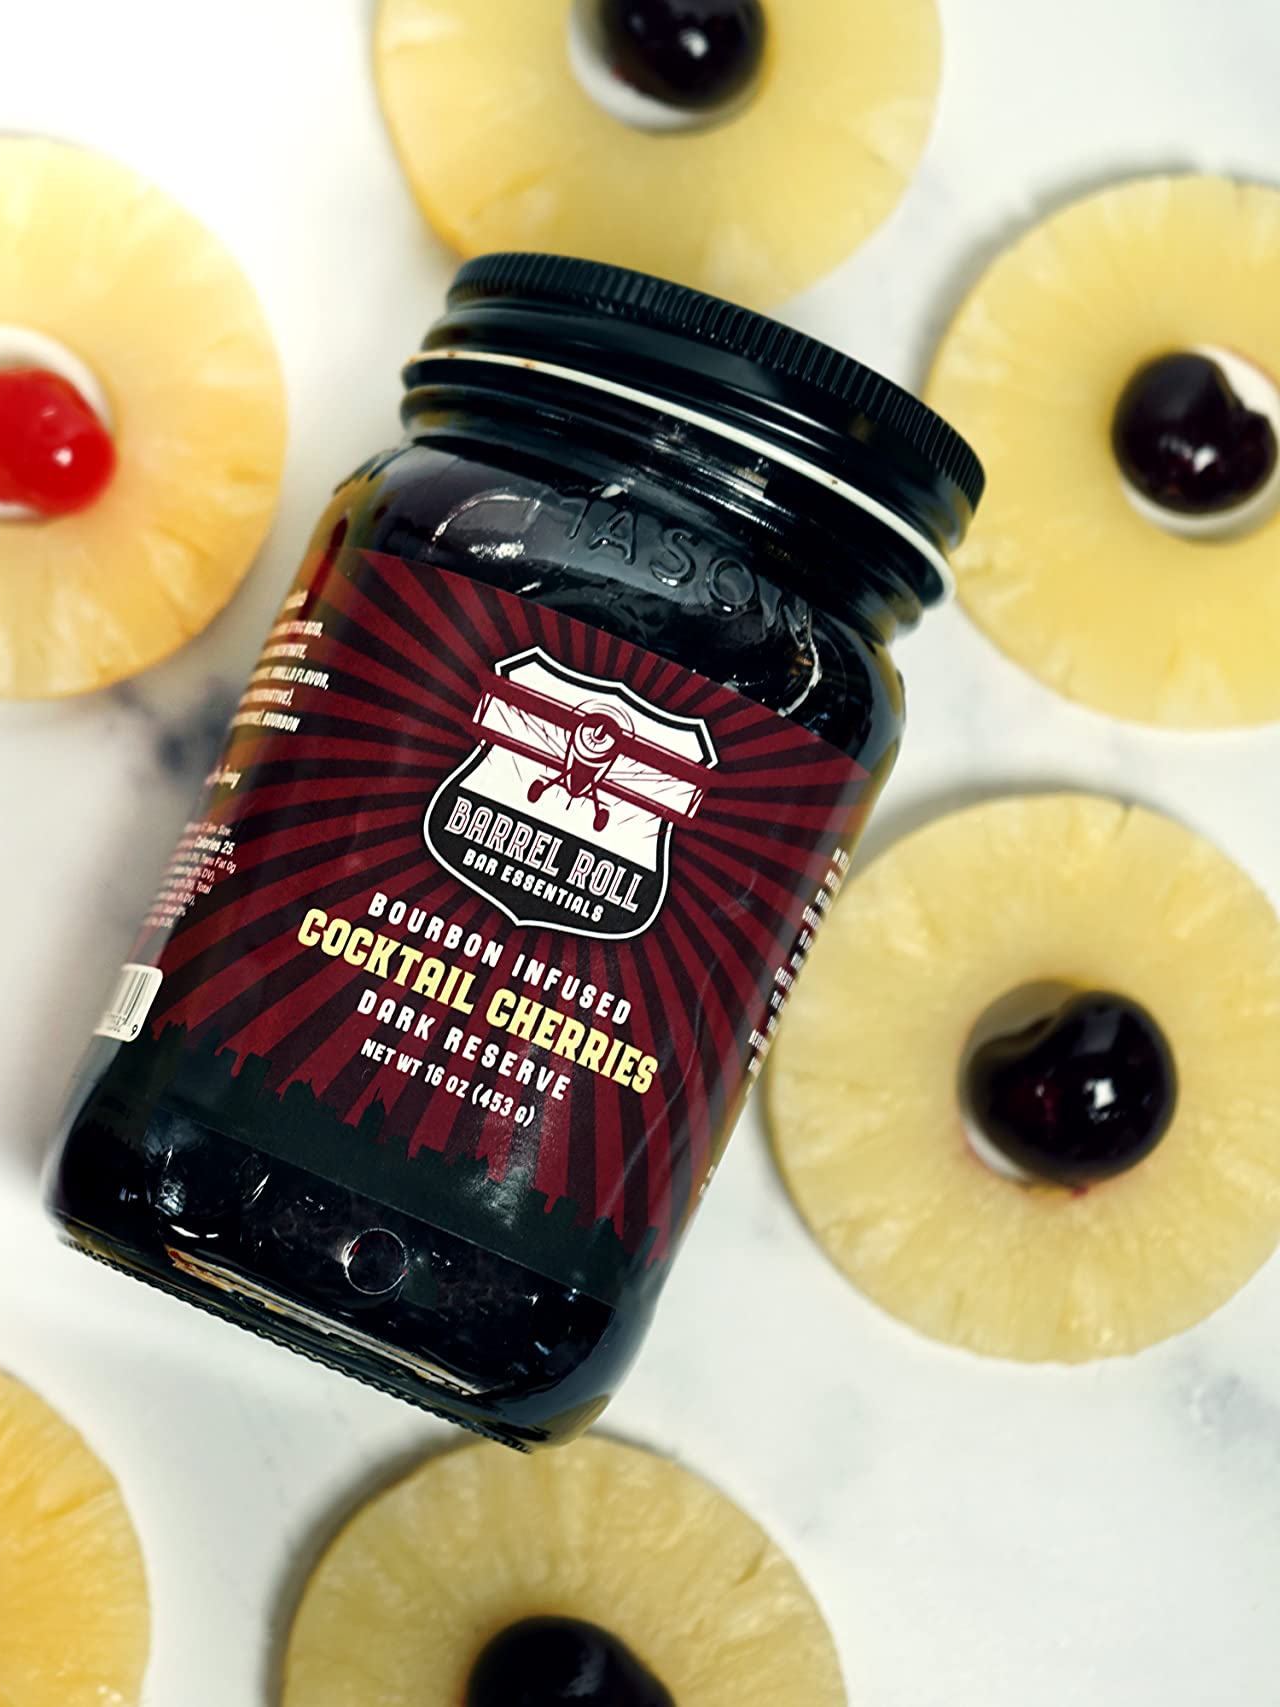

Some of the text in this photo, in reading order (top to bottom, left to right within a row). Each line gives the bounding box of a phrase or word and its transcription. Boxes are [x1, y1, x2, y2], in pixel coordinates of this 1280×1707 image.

[262, 711, 301, 733] BOURBON
[444, 796, 643, 913] BARREL ROLL
[462, 848, 604, 923] BAR ESSENTIALS
[297, 908, 659, 1094] COCKTAIL CHERRIES
[368, 892, 632, 1025] BOURBON INFUSED
[357, 989, 571, 1101] DARK RESERVE
[361, 1038, 395, 1066] NET
[397, 1055, 423, 1077] WT
[425, 1063, 444, 1085] 16
[471, 1083, 514, 1117] (453
